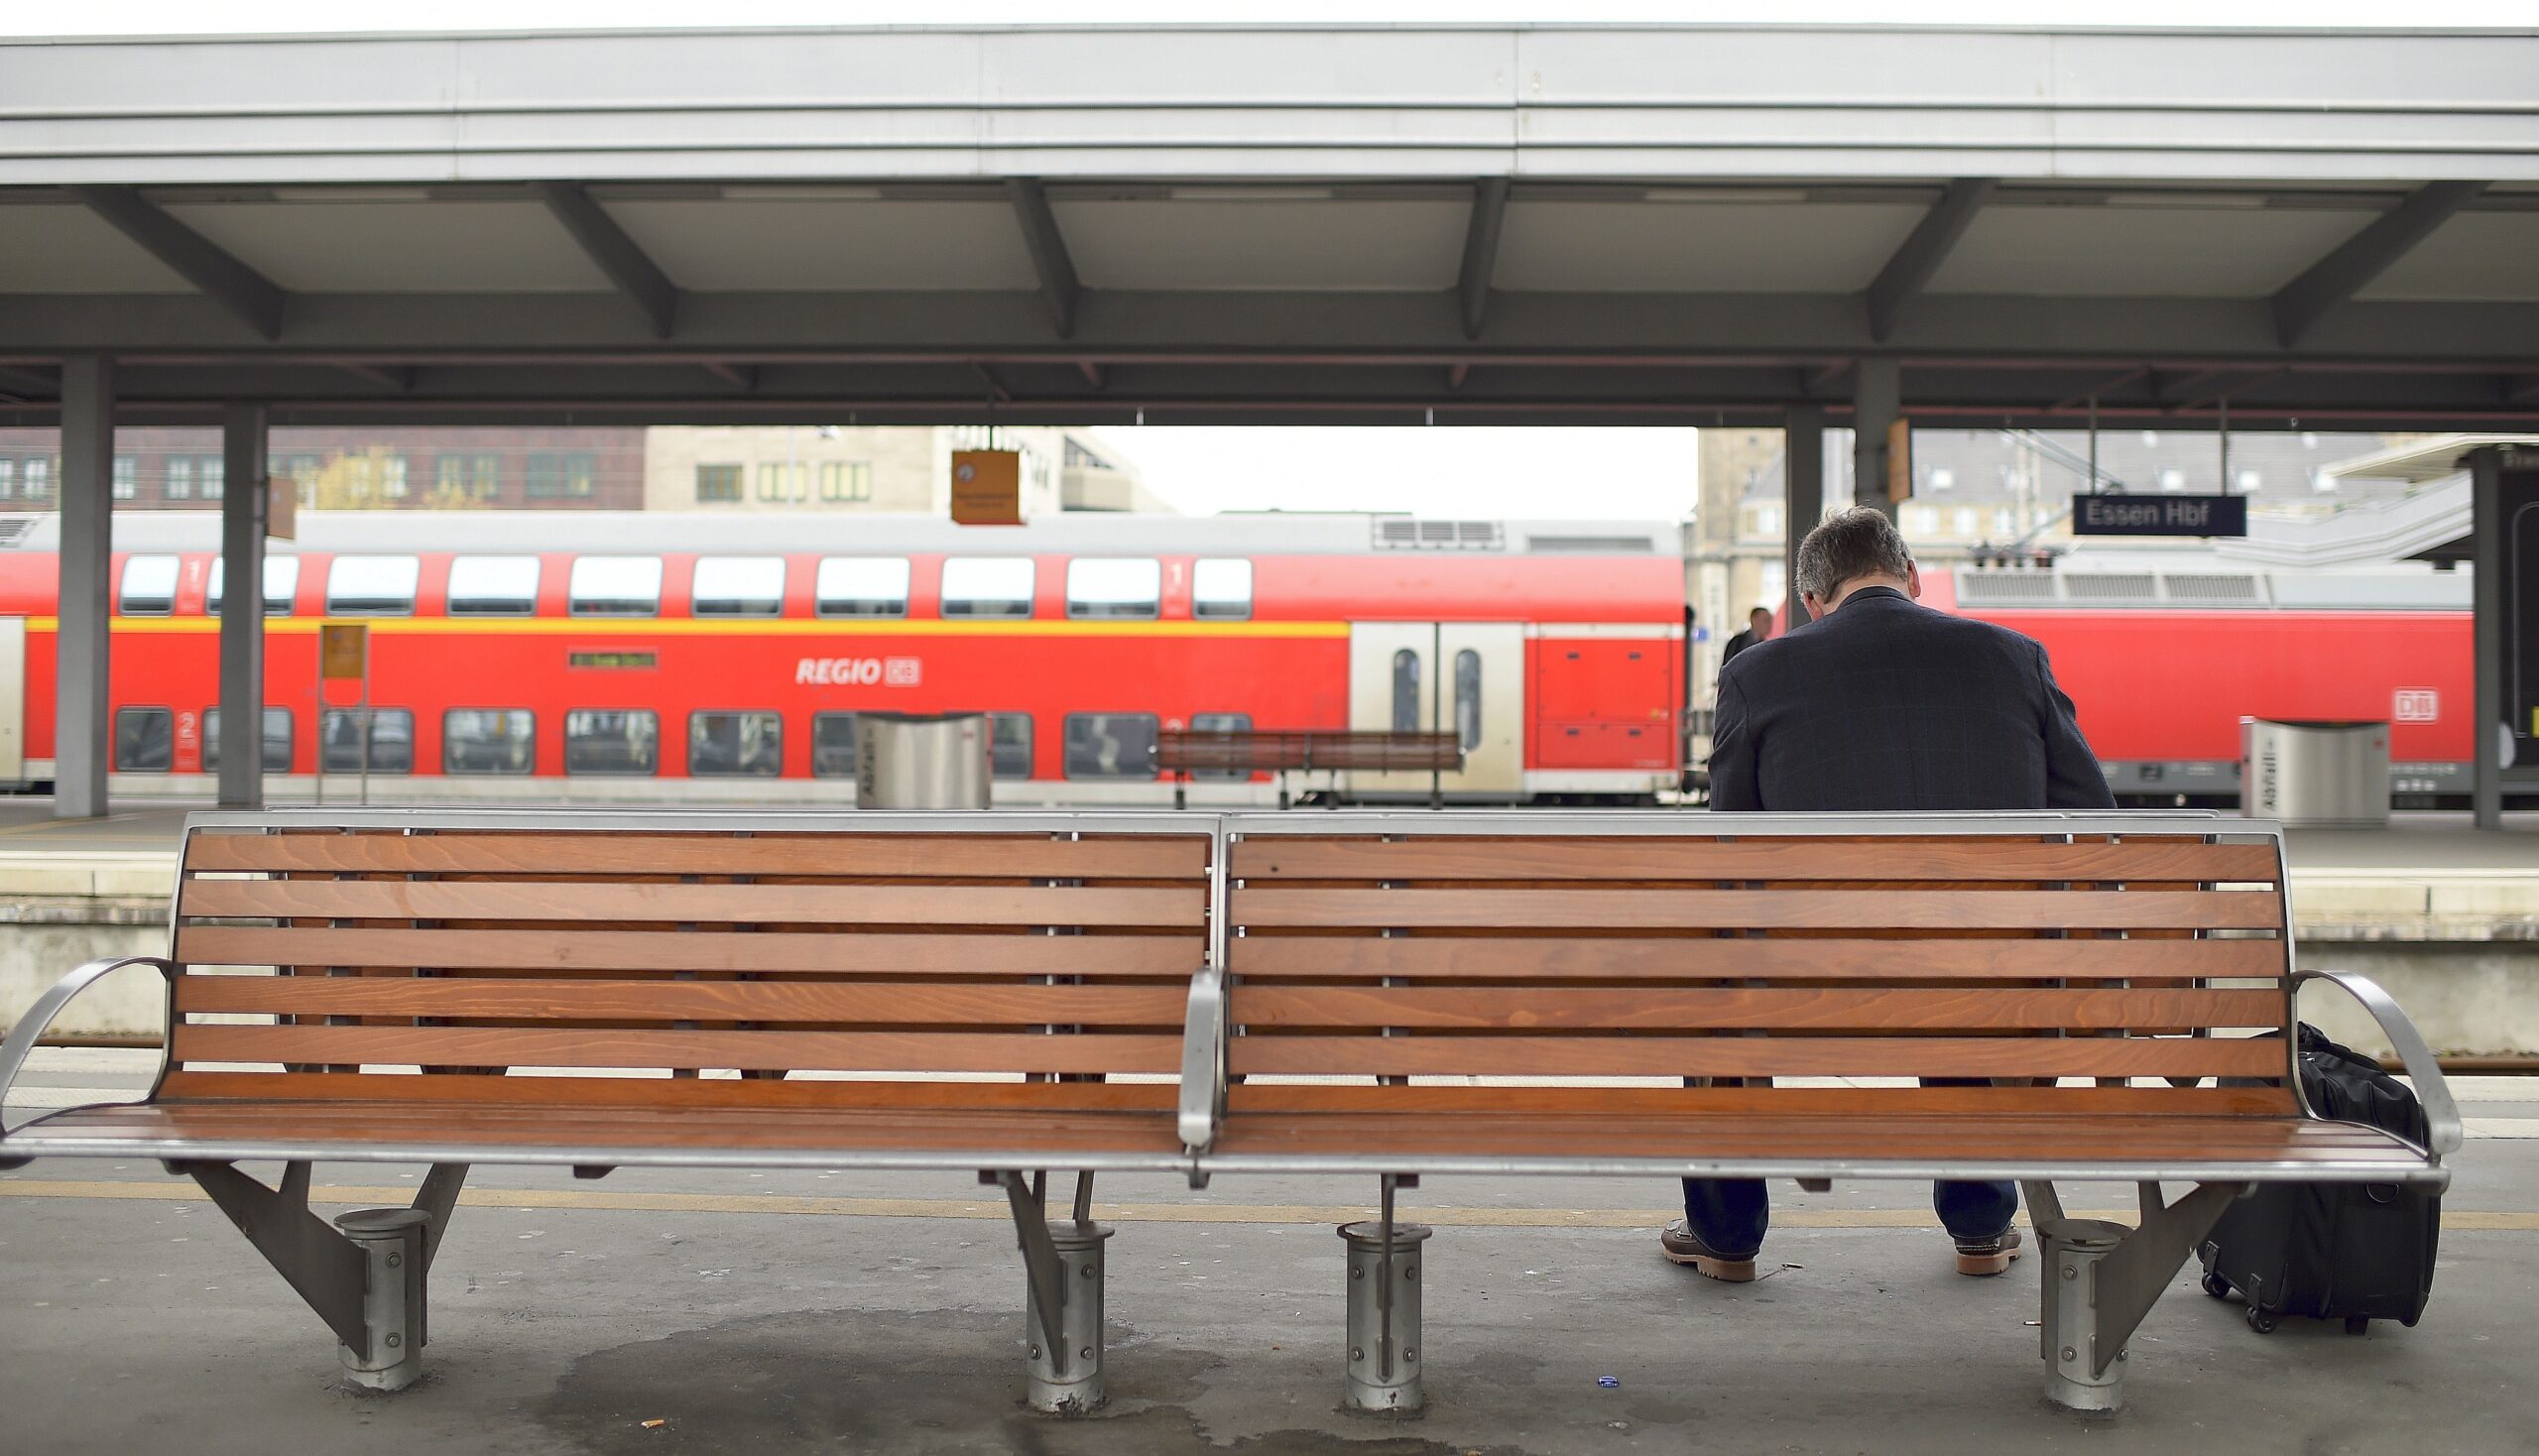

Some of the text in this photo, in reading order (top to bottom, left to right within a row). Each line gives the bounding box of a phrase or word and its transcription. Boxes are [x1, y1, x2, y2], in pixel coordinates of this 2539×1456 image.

[2086, 499, 2210, 527] Essen Hbf
[794, 658, 883, 685] REGIO
[2396, 692, 2435, 718] DB
[179, 711, 196, 739] 2
[2263, 751, 2276, 811] Abfall
